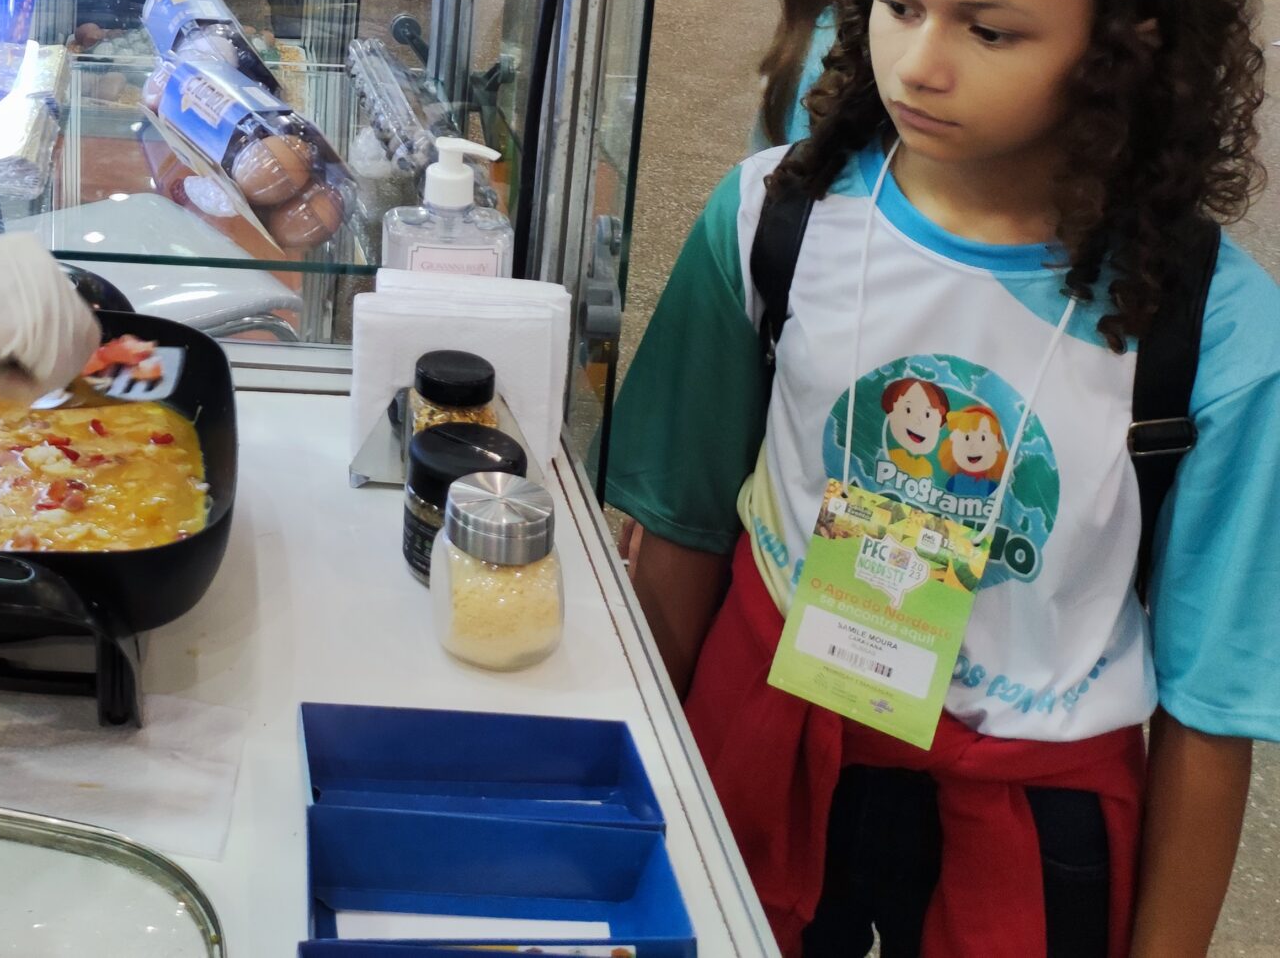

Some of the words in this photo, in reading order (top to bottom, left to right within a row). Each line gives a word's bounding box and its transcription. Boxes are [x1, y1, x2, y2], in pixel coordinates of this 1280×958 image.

[876, 460, 1001, 519] Programa
[811, 577, 822, 589] O
[825, 583, 859, 605] Agro
[862, 597, 881, 613] do
[884, 605, 952, 641] Nordeste
[868, 633, 899, 651] MOURA
